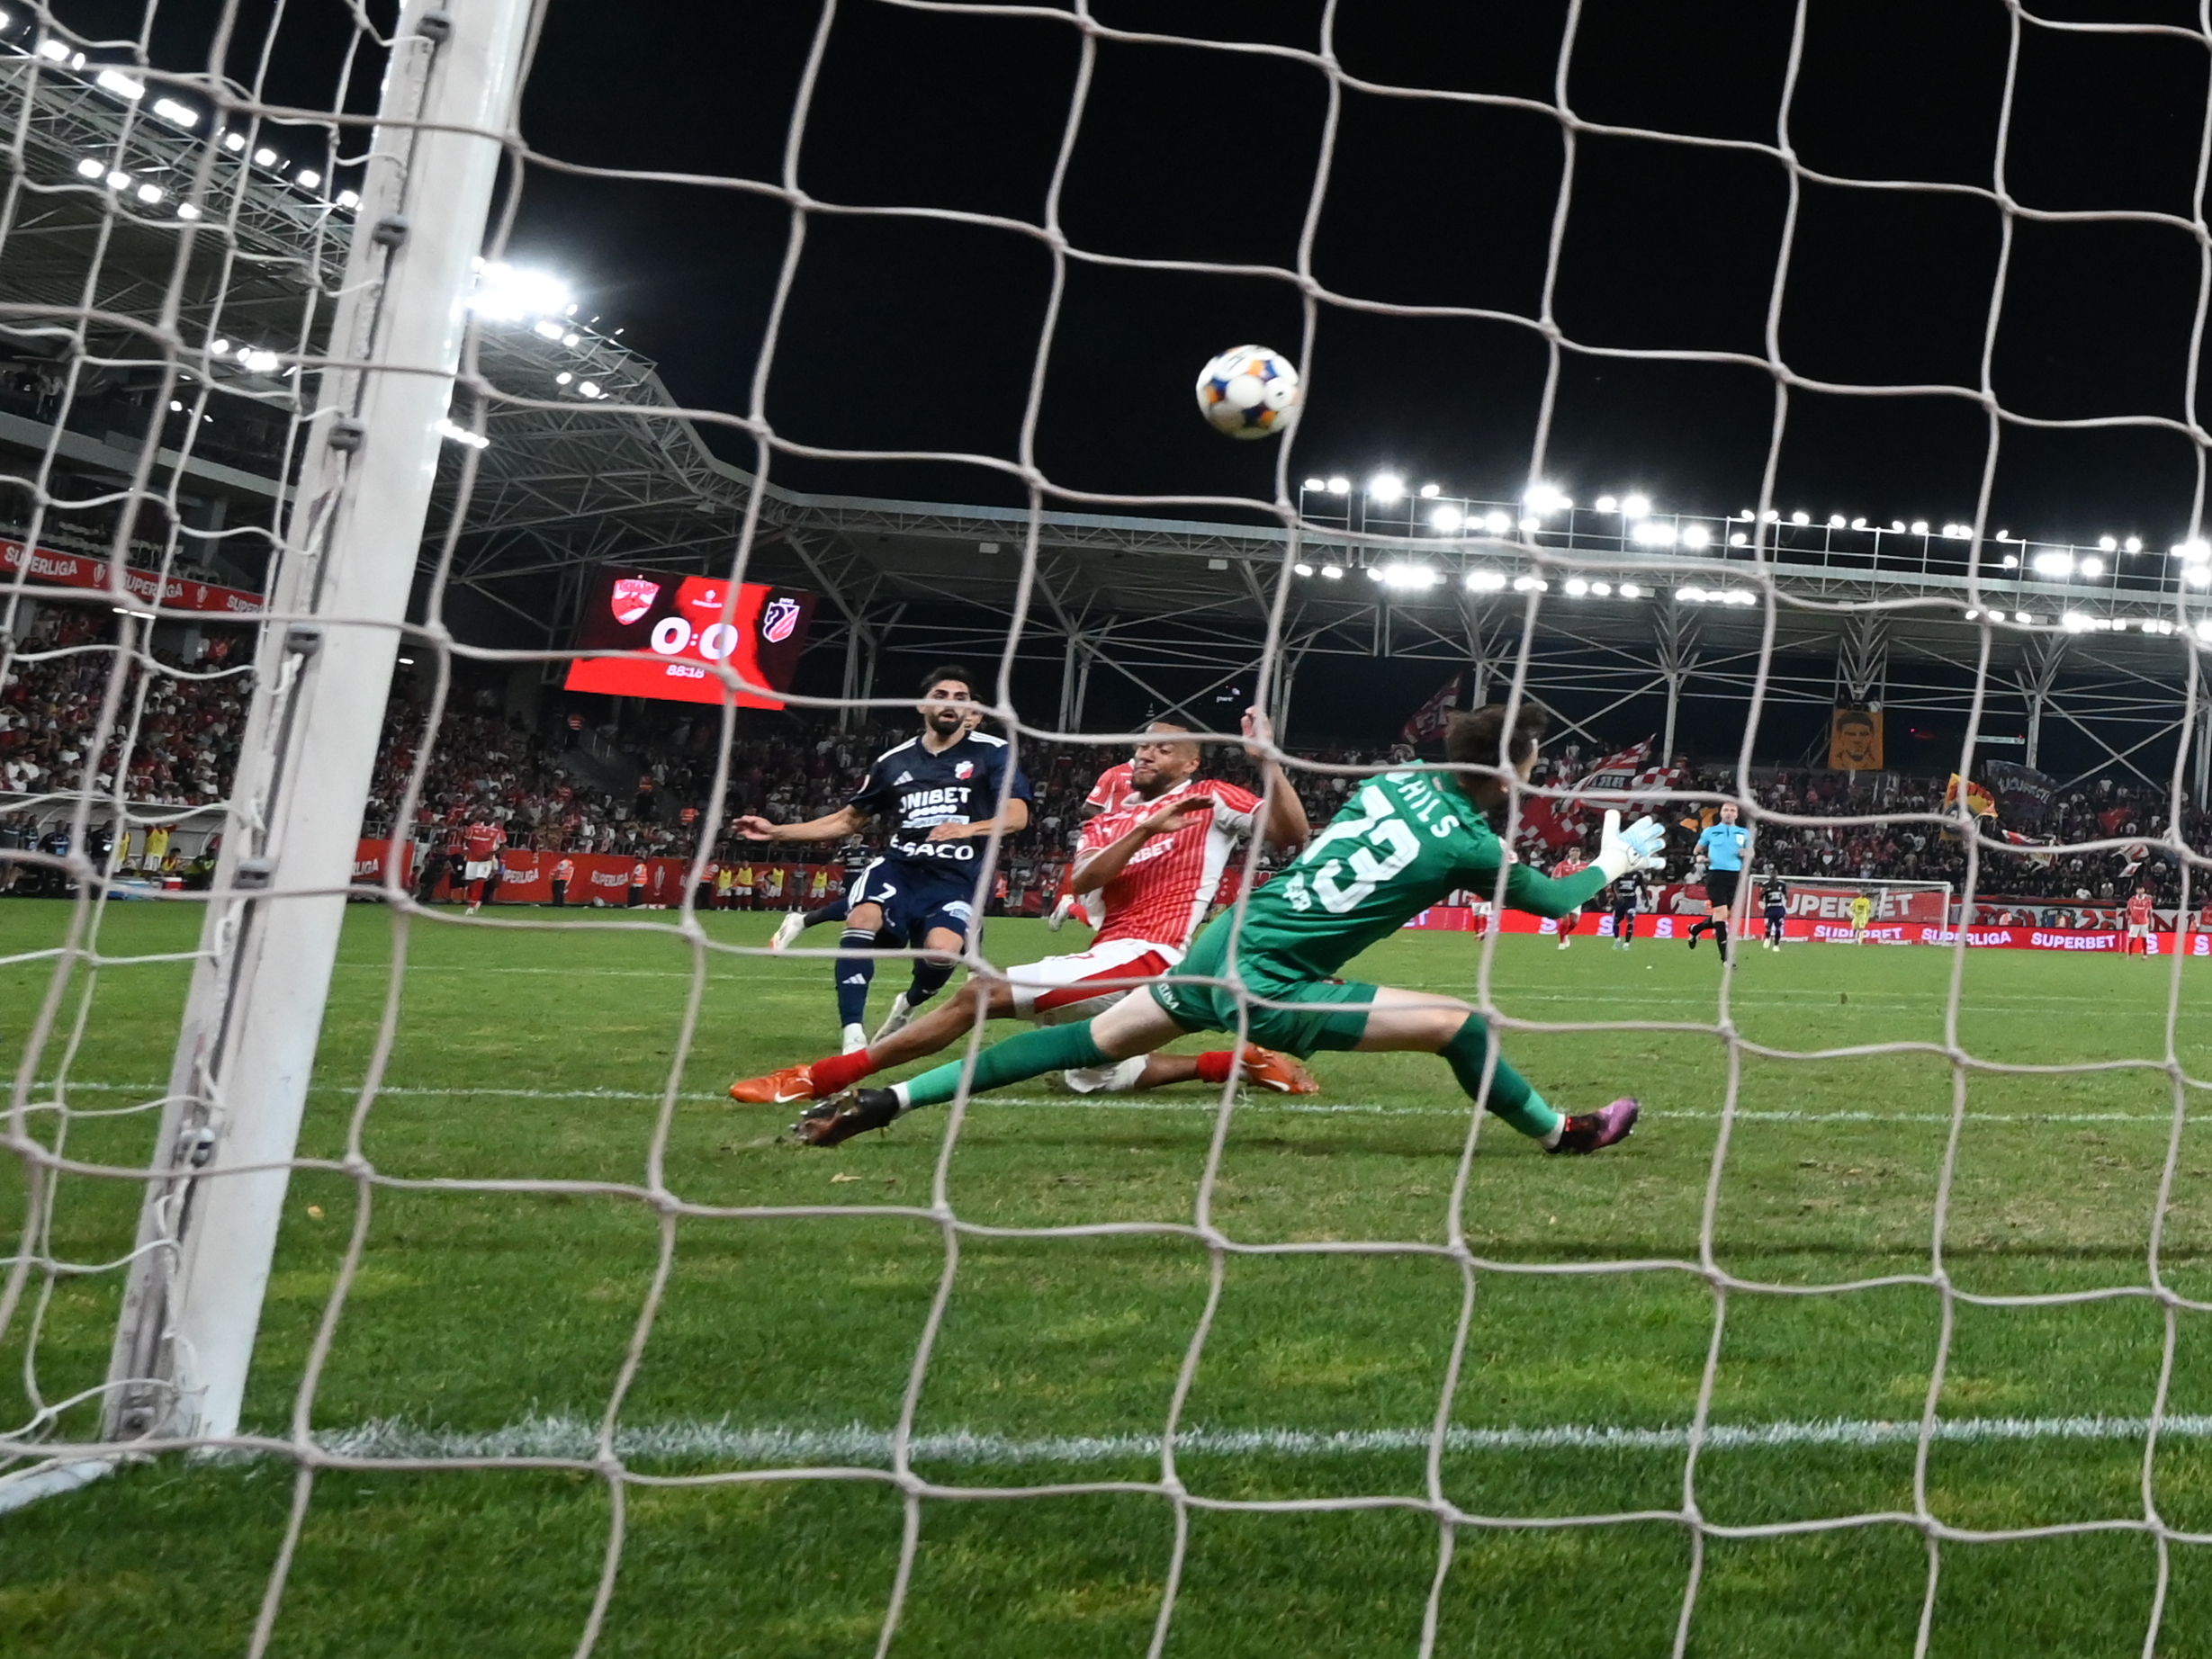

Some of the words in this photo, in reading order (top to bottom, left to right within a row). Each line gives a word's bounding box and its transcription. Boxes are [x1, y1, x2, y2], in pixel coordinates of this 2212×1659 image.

[4, 545, 78, 576] SUERLIGA
[651, 616, 739, 660] 0:0
[1386, 771, 1460, 838] HILS
[889, 833, 975, 860] ESACO
[1302, 784, 1422, 914] 73
[2031, 932, 2116, 949] SUPERBET
